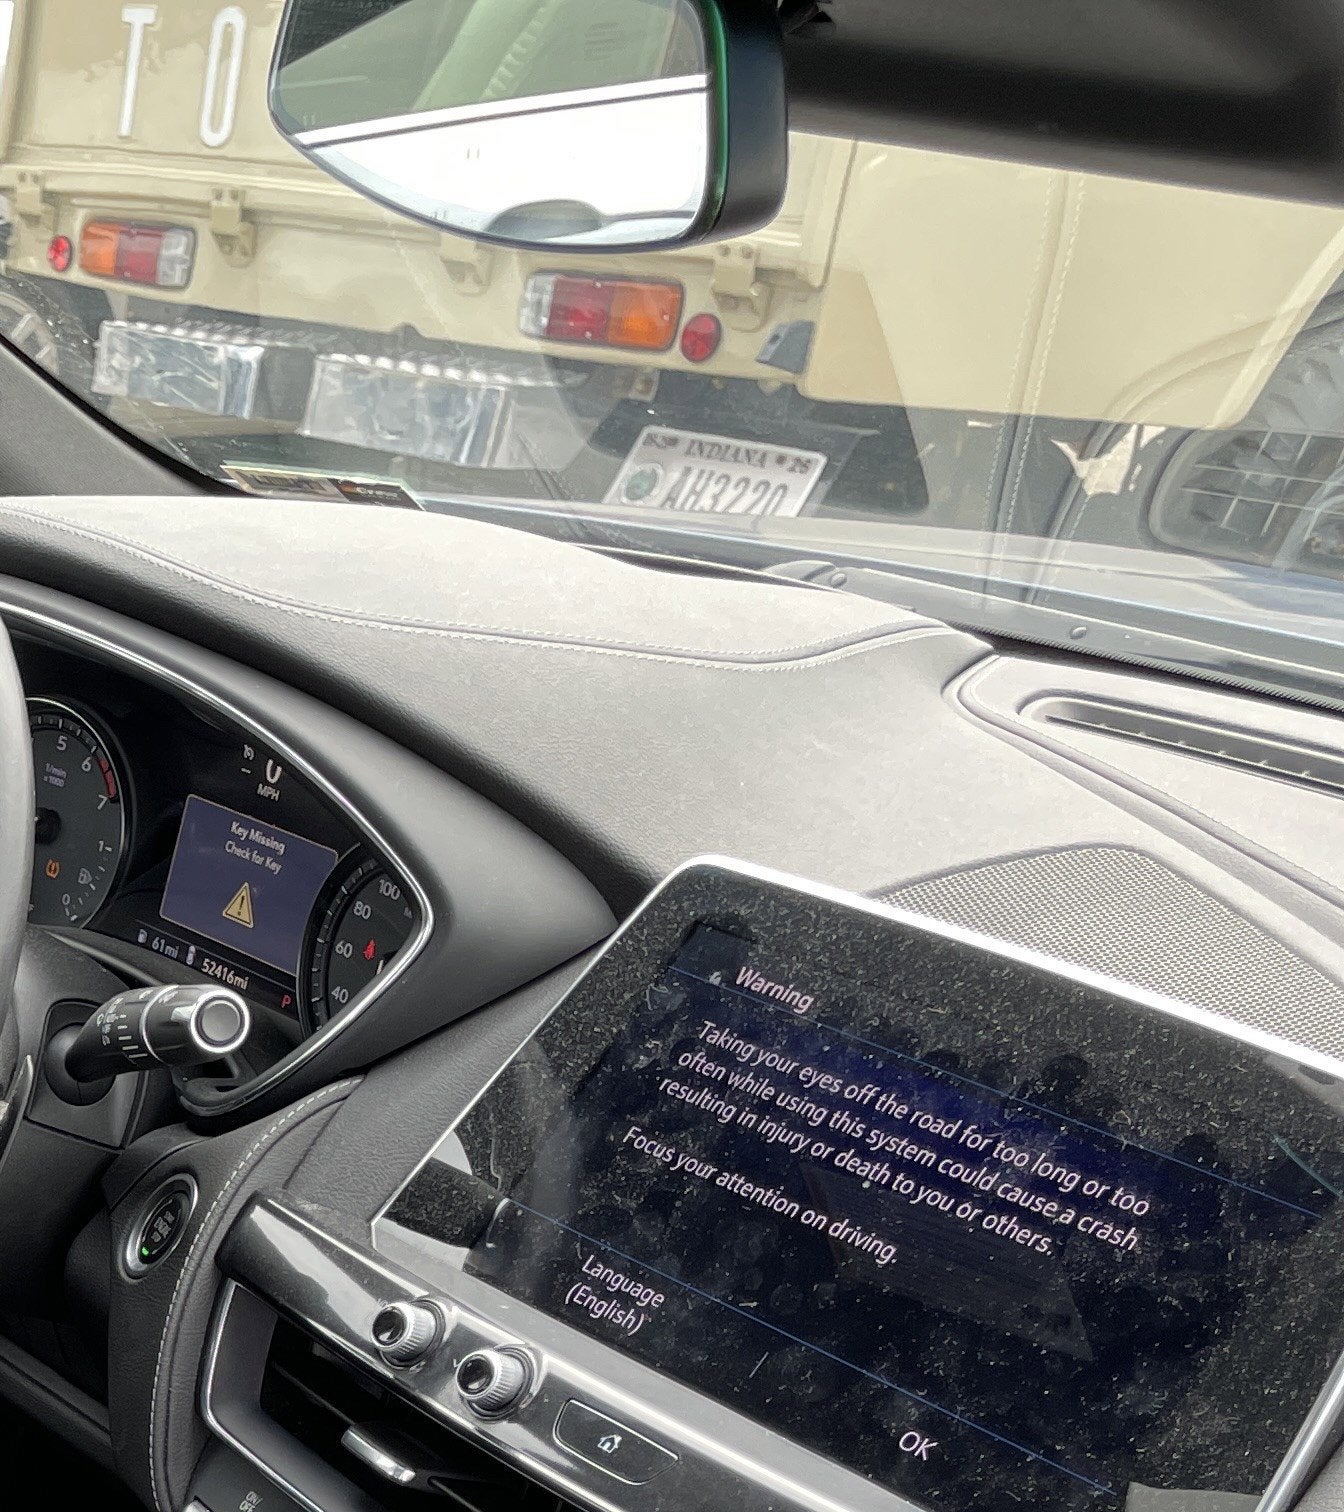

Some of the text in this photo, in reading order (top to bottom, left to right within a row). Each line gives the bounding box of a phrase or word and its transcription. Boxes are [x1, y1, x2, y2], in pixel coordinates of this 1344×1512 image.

[684, 439, 767, 468] INDIANA
[57, 736, 67, 751] 5
[81, 756, 91, 772] 6
[97, 794, 108, 810] 7
[257, 783, 280, 801] MPH
[231, 821, 286, 855] Key Missing
[225, 840, 282, 875] Check for Key
[378, 878, 400, 900] 100
[353, 901, 371, 920] 80
[335, 940, 353, 959] 60
[281, 994, 291, 1008] P
[331, 985, 349, 1004] 40
[735, 966, 815, 1014] Warning
[698, 1020, 1150, 1217] Taking your eyes off the road for too long or too
[678, 1051, 1138, 1251] often while using this system could cause a crash
[659, 1077, 1054, 1256] resulting in injury or death to you or others.
[622, 1126, 898, 1265] Focus your attention on driving.
[581, 1254, 665, 1308] Language
[565, 1282, 645, 1336] (English)
[899, 1431, 939, 1460] OK
